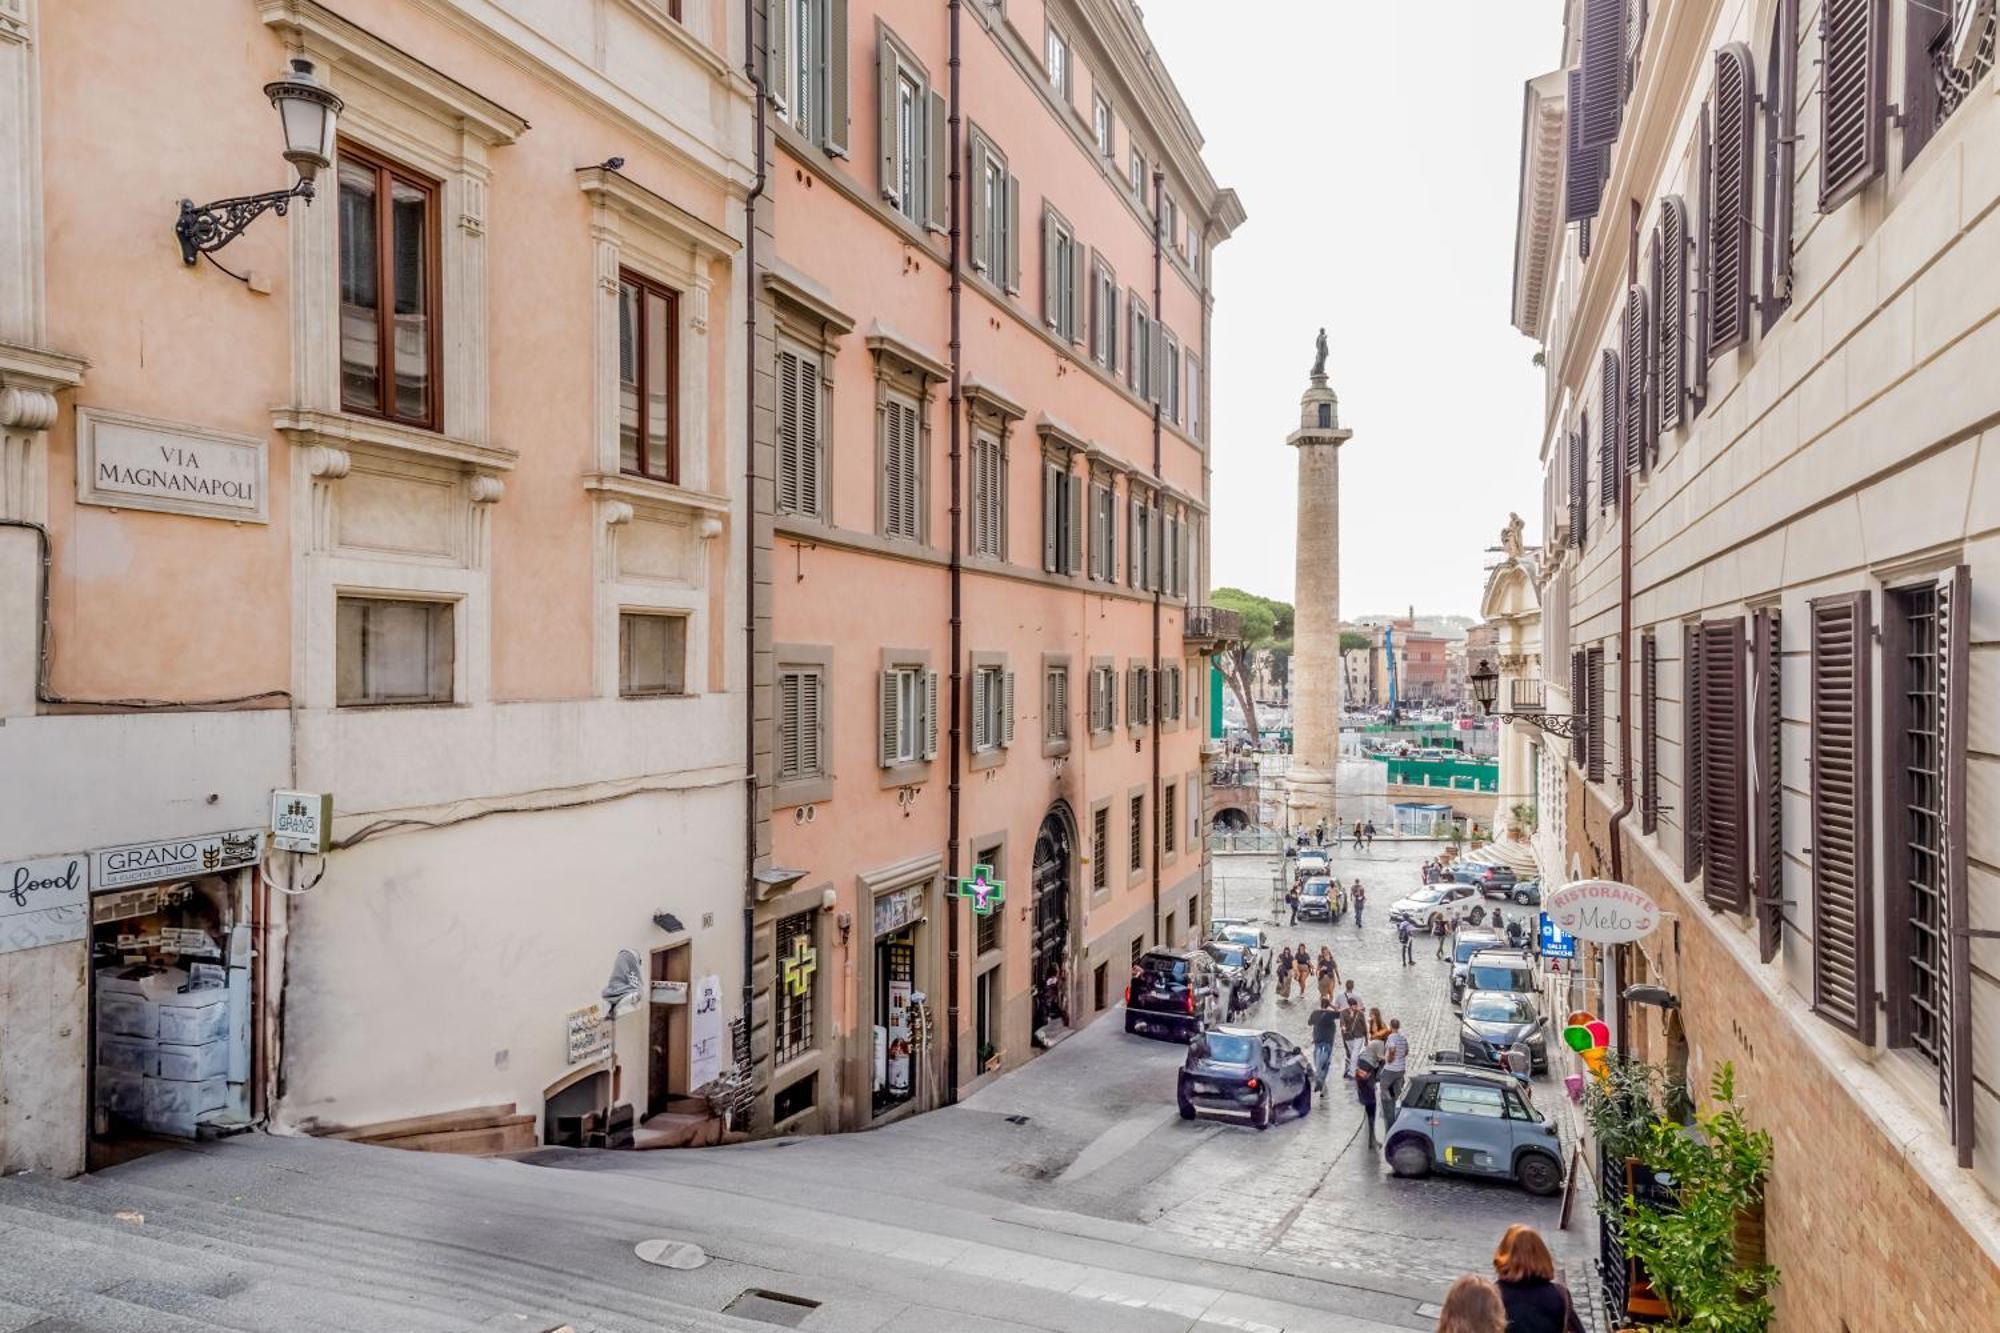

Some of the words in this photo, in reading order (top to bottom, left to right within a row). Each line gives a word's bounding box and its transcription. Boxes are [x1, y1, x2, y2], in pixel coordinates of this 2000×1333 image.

[160, 446, 199, 469] VIA
[99, 463, 252, 500] MAGNANAPOLI
[106, 843, 197, 870] GRANO
[8, 860, 80, 907] food
[1555, 887, 1654, 913] RISTORANTE
[1578, 906, 1632, 930] Melo
